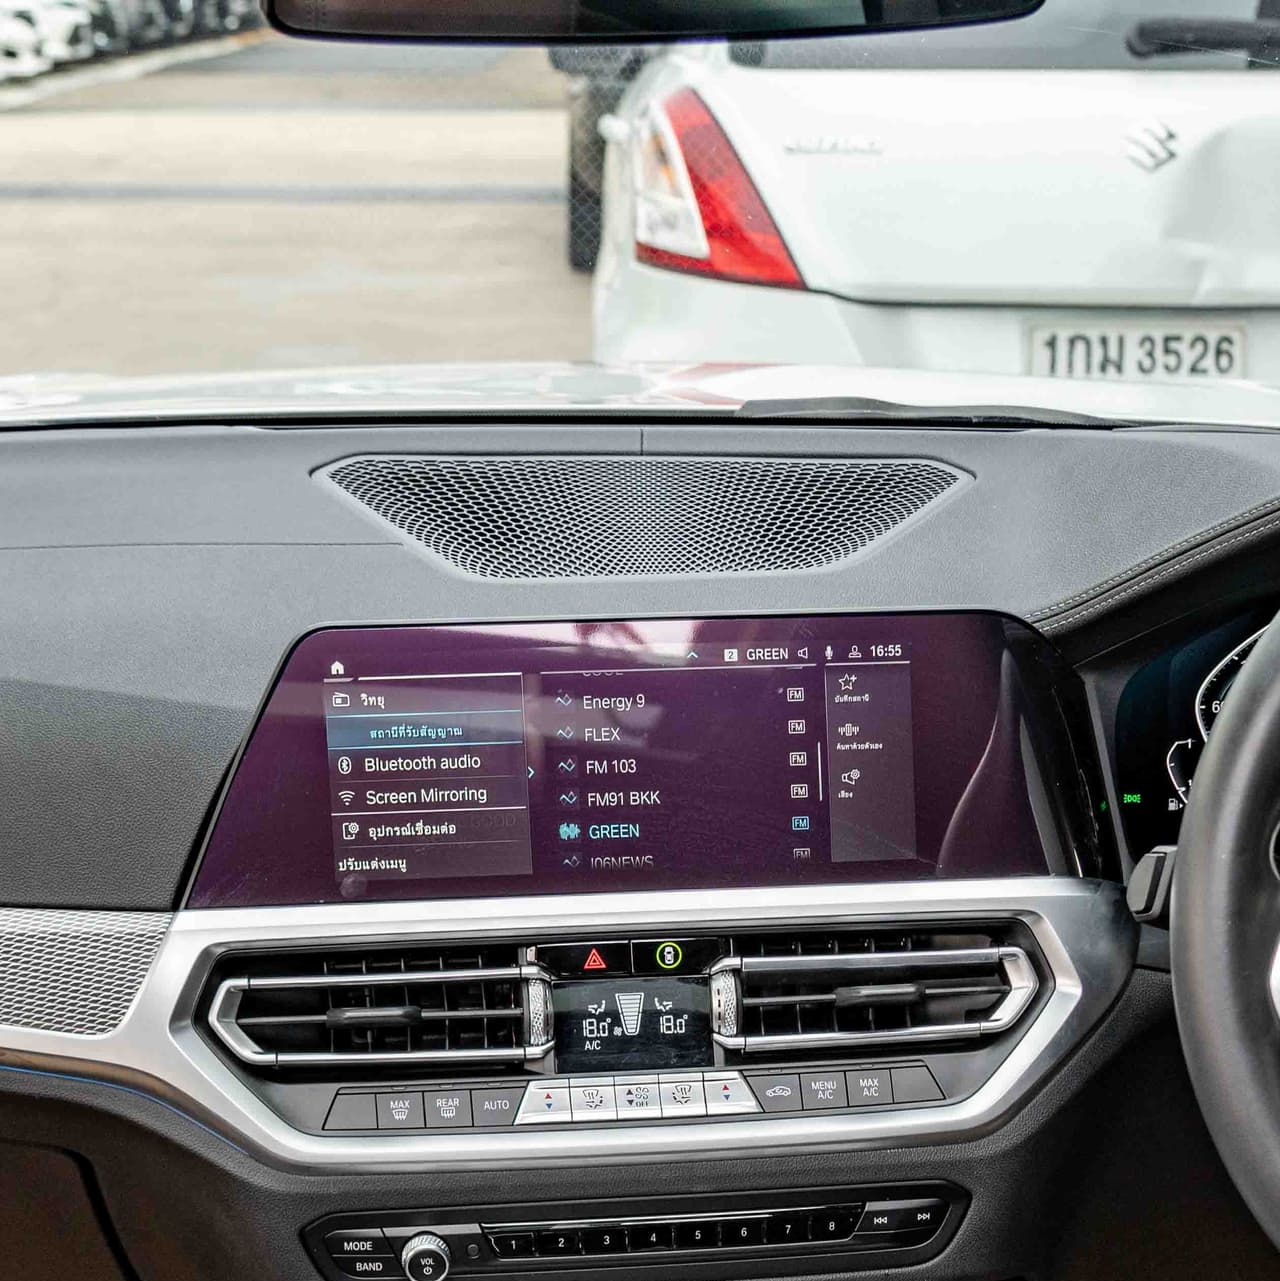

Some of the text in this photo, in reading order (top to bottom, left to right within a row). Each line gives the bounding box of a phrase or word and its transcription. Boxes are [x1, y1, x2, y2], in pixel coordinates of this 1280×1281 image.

[1136, 334, 1235, 376] 3526
[746, 648, 789, 661] GREEN
[869, 644, 903, 657] 16:55
[360, 692, 386, 710] วิทยุ
[583, 693, 646, 711] Energy 9
[584, 727, 621, 742] FLEX
[364, 753, 482, 773] Bluetooth audio
[585, 758, 637, 774] FM 103
[365, 786, 488, 805] Screen Mirroring
[587, 790, 661, 807] FM91 BKK
[588, 822, 640, 840] GREEN
[584, 1040, 602, 1051] A/C
[811, 1080, 837, 1090] MENU
[859, 1077, 880, 1087] MAX
[817, 1089, 834, 1100] A/C
[862, 1086, 880, 1097] A/C
[389, 1099, 411, 1110] MAX
[435, 1097, 461, 1108] REAR
[483, 1099, 510, 1111] AUTO
[635, 1100, 650, 1108] OFF
[740, 1226, 749, 1238] 6
[784, 1223, 792, 1235] 7
[828, 1220, 836, 1232] 8
[602, 1234, 611, 1246] 3
[649, 1232, 658, 1243] 4
[694, 1230, 702, 1241] 5
[343, 1241, 374, 1252] MODE
[510, 1239, 517, 1250] 1
[557, 1237, 566, 1248] 2
[355, 1261, 384, 1273] BAND
[420, 1257, 436, 1267] VOL
